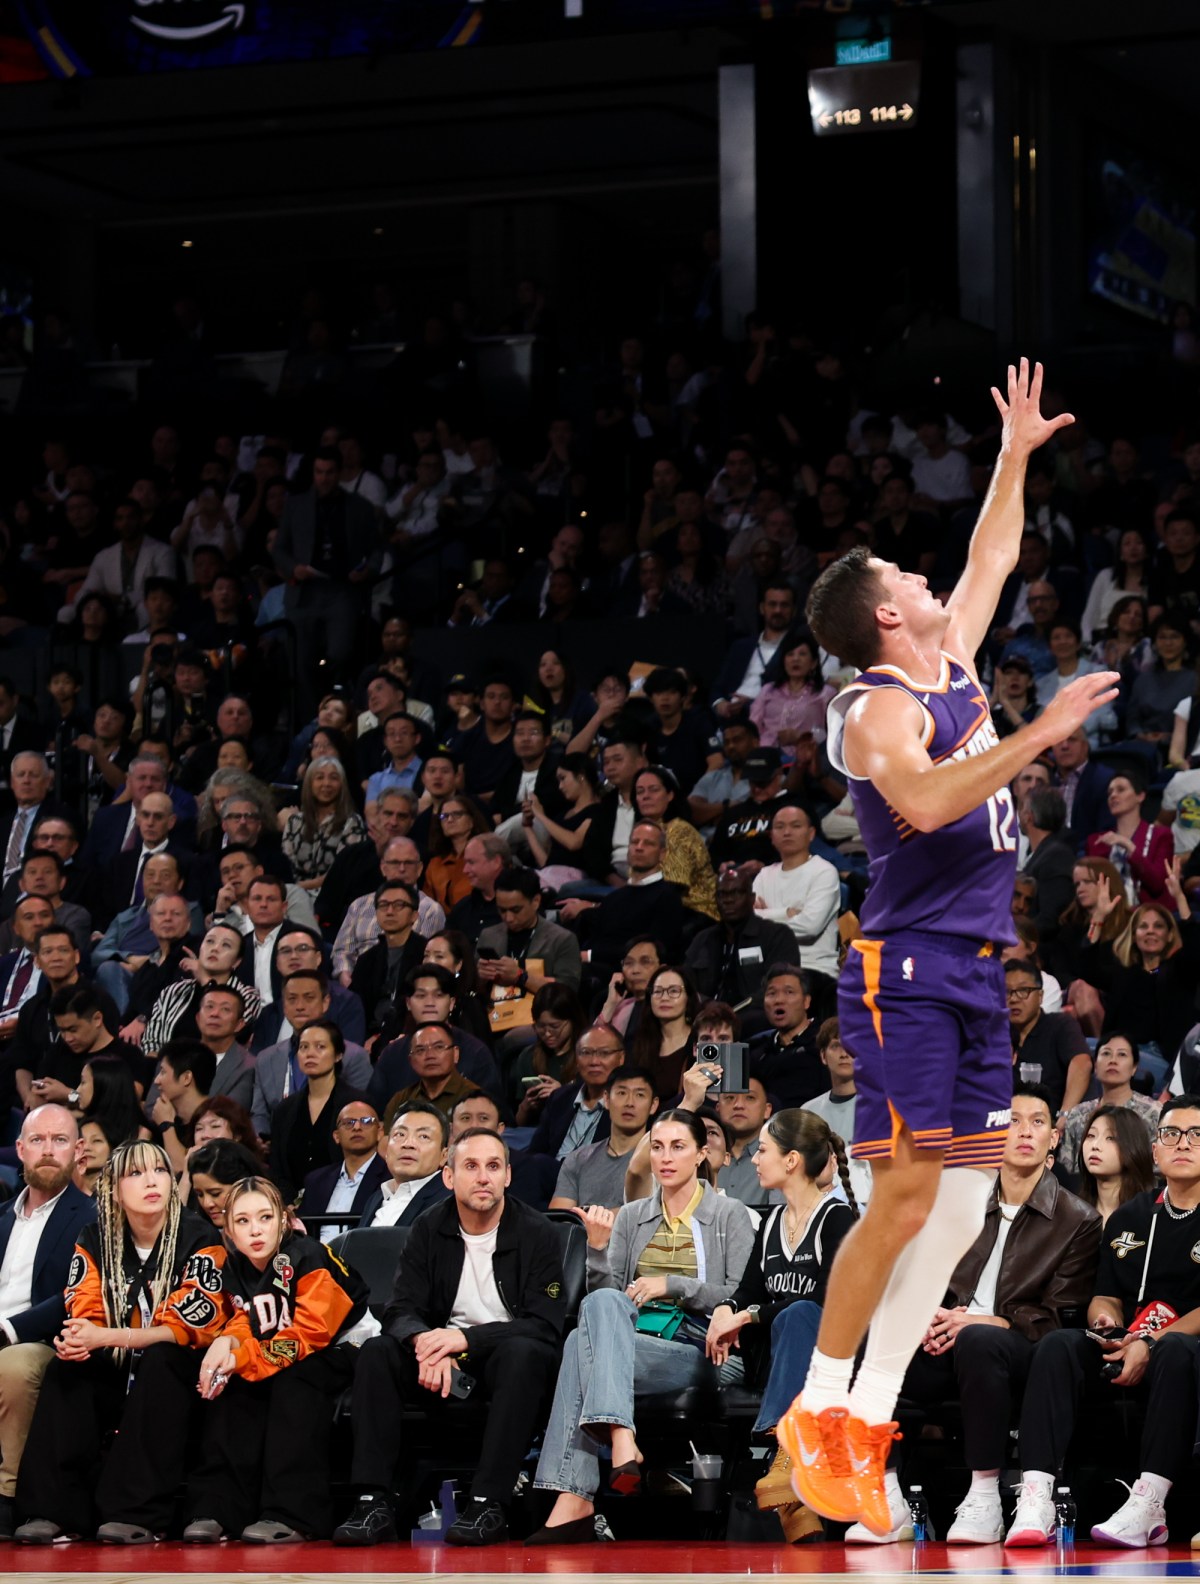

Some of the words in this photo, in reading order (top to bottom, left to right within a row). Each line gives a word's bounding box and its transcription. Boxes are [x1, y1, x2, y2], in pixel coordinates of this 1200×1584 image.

[834, 108, 860, 125] 113
[870, 105, 897, 122] 114
[986, 786, 1016, 851] 12
